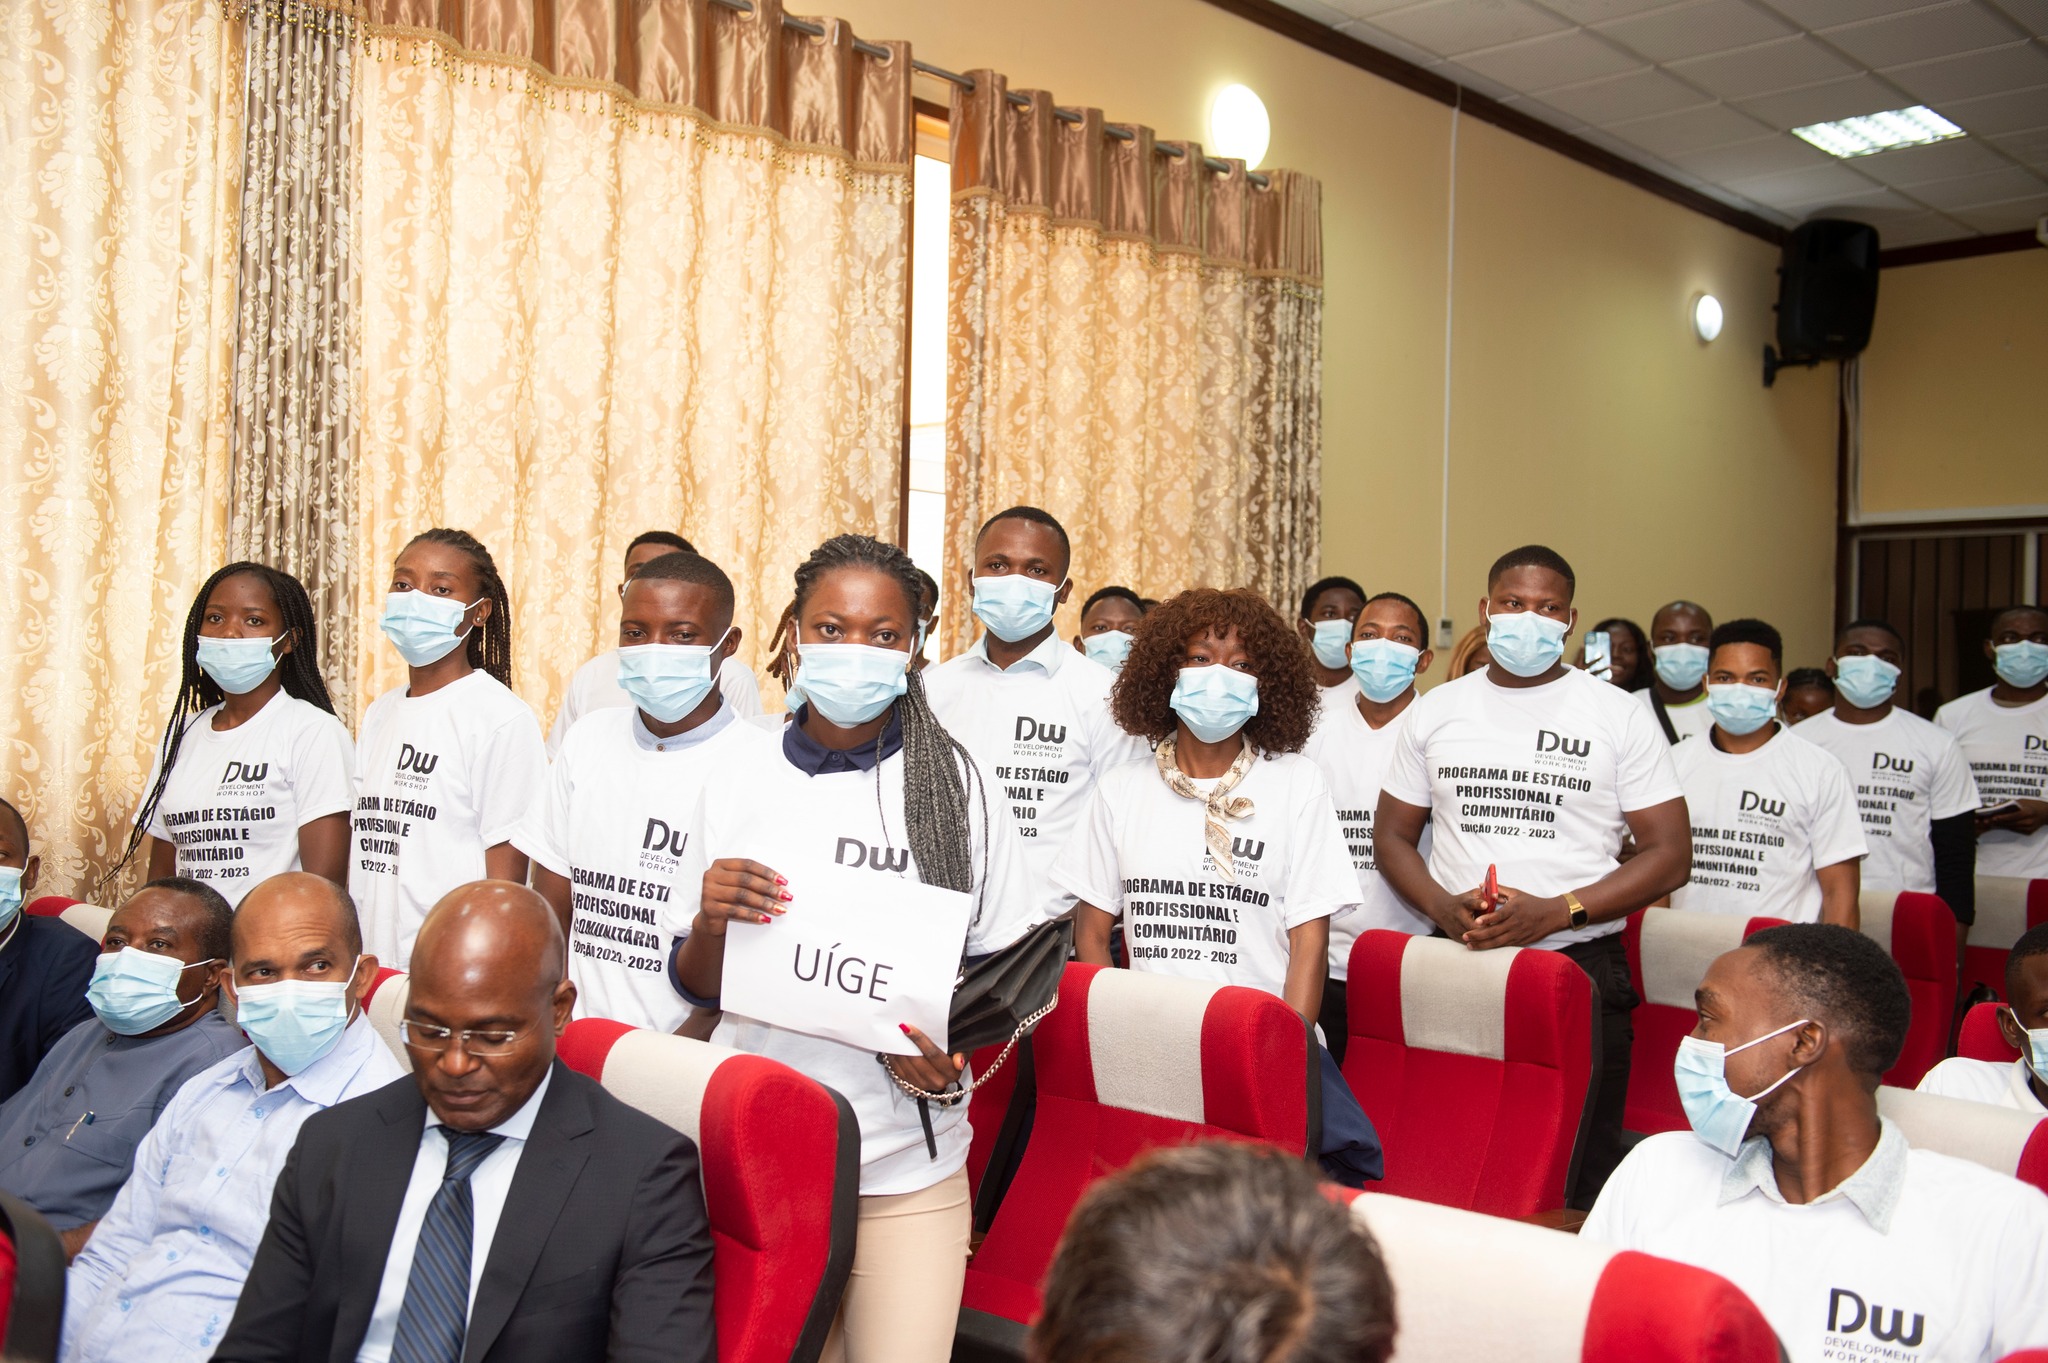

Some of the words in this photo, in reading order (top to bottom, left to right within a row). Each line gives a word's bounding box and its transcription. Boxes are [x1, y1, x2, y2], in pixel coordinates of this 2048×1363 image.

[1013, 750, 1062, 759] WORKSHOP
[1014, 743, 1063, 752] DEVELOPMENT
[1534, 760, 1587, 772] WORKSHOP
[1535, 753, 1587, 765] DEVELOPMENT
[996, 766, 1011, 779] DE
[1015, 767, 1069, 784] ESTÁGIO
[2010, 764, 2021, 772] DE
[1438, 766, 1508, 781] PROGRAMA
[1512, 770, 1528, 782] DE
[1533, 772, 1592, 792] ESTÁGIO
[1037, 789, 1044, 801] E
[1456, 785, 1551, 805] PROFISSIONAL
[1555, 794, 1564, 806] E
[1858, 785, 1869, 794] DE
[1874, 786, 1915, 800] ESTÁGIO
[202, 808, 214, 822] DE
[217, 806, 276, 821] ESTÁGIO
[384, 798, 394, 812] DE
[395, 799, 437, 820] ETÁGIO
[1462, 804, 1555, 822] COMUNITÁRIO
[1891, 802, 1897, 812] E
[242, 828, 250, 840] E
[401, 823, 411, 837] E
[1461, 823, 1491, 834] EDIÇÃO
[1494, 825, 1520, 836] 2022
[1529, 828, 1555, 839] 2023
[1722, 830, 1737, 840] DE
[1740, 832, 1784, 848] ESTÁGIO
[1758, 851, 1765, 862] E
[195, 869, 213, 879] 2022
[220, 867, 249, 878] 2023
[570, 866, 615, 892] GRAMA
[618, 877, 637, 895] DE
[1736, 881, 1760, 891] 2023
[1188, 881, 1206, 897] DE
[1210, 884, 1270, 908] ESTÁGIO
[1131, 901, 1231, 922] PROFISSIONAL
[1234, 909, 1239, 923] E
[1134, 924, 1236, 944] COMUNITÁRIO
[1133, 945, 1168, 960] EDIÇÃO
[1171, 948, 1201, 961] 2022
[1211, 950, 1237, 964] 2023
[628, 956, 662, 973] 2023
[794, 942, 893, 1002] UÍGE
[1824, 1336, 1919, 1362] DEVELOPMENT
